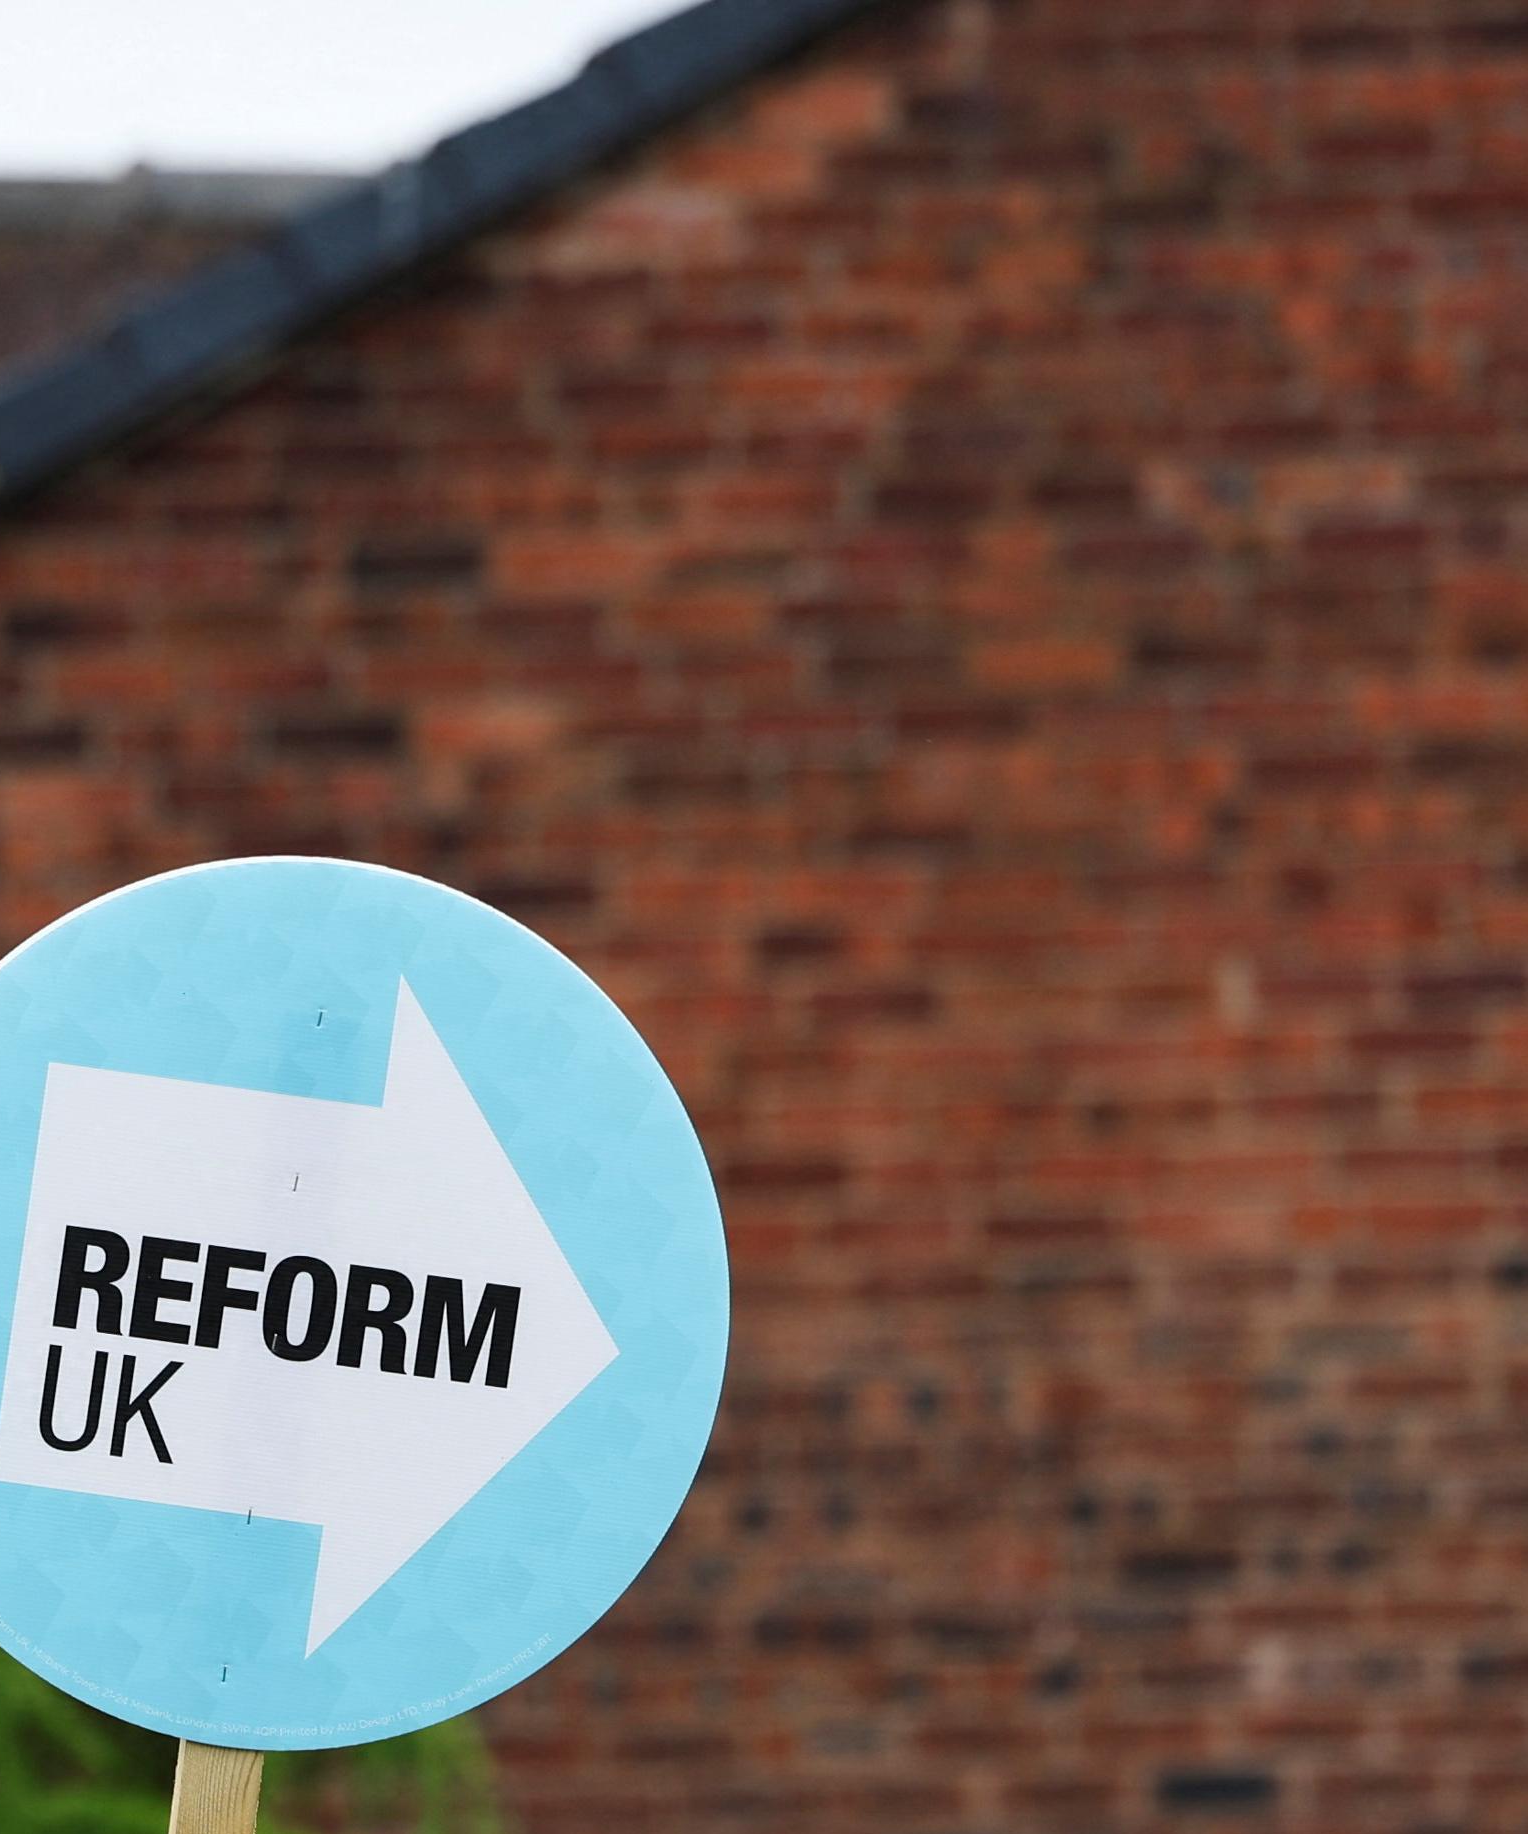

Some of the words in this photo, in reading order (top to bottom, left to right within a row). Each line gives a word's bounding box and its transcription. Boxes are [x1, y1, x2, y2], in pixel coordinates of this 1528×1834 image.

[52, 1225, 522, 1389] REFORM
[39, 1344, 185, 1465] UK
[358, 1712, 395, 1730] Design
[473, 1659, 515, 1688] Preston
